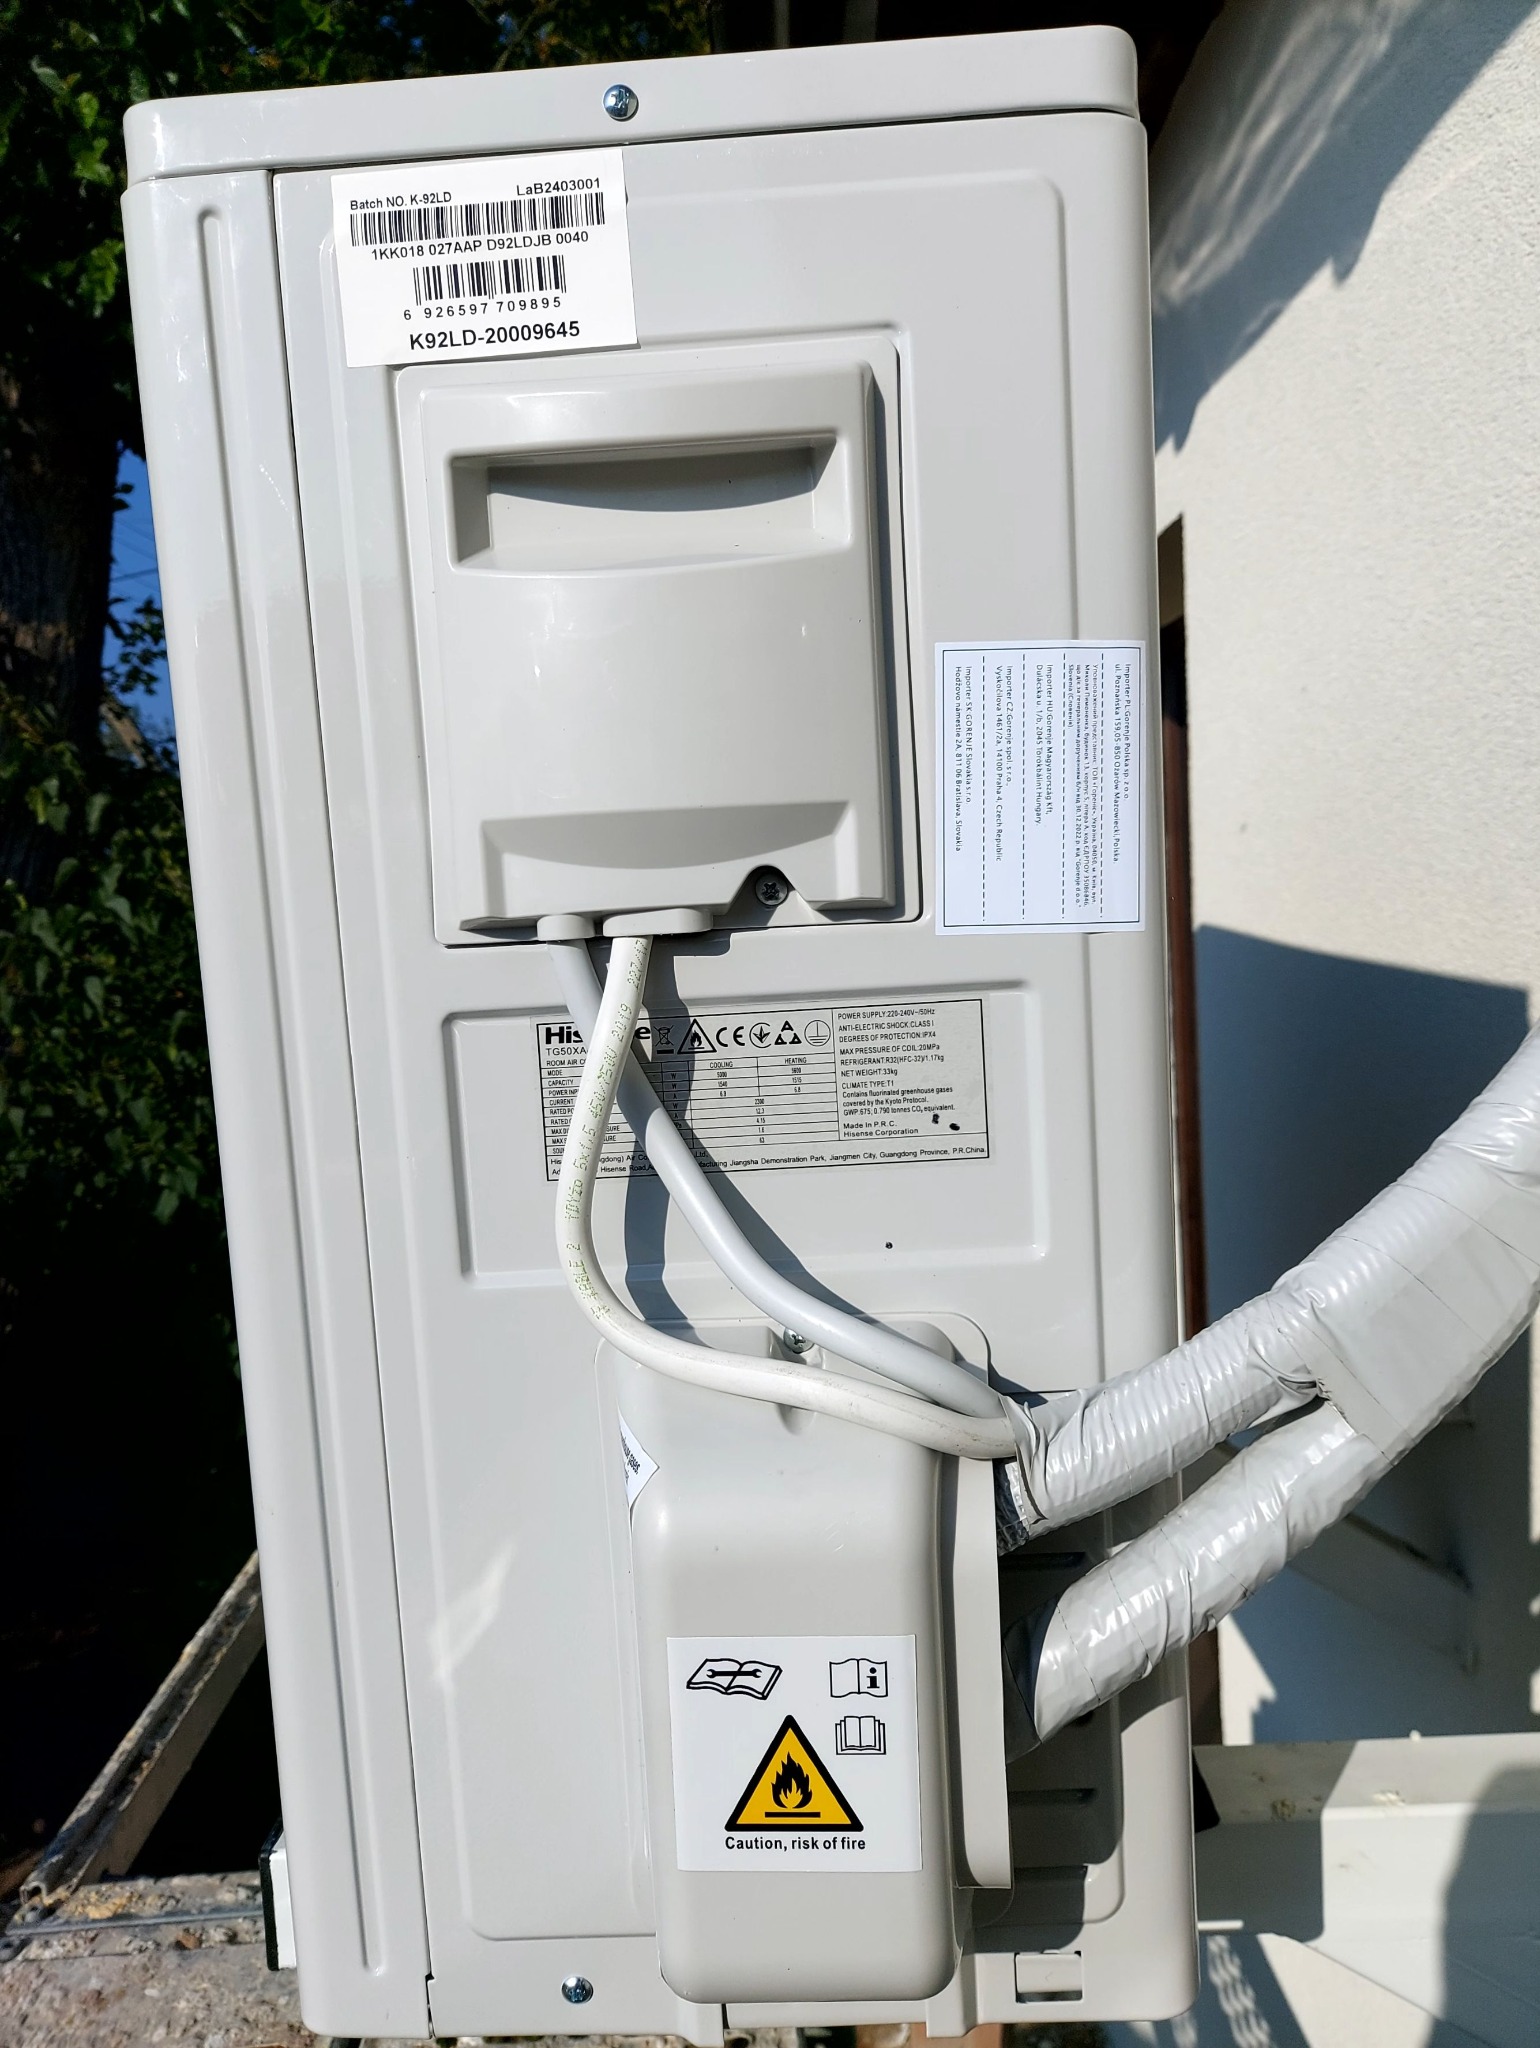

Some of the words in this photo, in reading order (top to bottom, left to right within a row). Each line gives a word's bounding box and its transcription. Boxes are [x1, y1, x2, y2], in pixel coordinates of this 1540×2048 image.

[517, 178, 600, 196] LaB2403001
[350, 197, 383, 211] Batch
[386, 195, 407, 208] NO.
[410, 192, 451, 205] K-92LD
[372, 245, 424, 261] 1KK018
[429, 240, 482, 256] 027AAP
[488, 235, 551, 251] D92LDJB
[556, 230, 589, 245] 0040
[404, 309, 412, 320] 6
[424, 303, 488, 319] 926597
[497, 297, 561, 313] 709895
[409, 321, 580, 351] K92LD-20009645
[1005, 702, 1013, 744] CZ:Gorenje
[1045, 701, 1053, 744] HU:Gorenje
[1123, 700, 1131, 741] PL:Gorenje
[1005, 747, 1013, 764] spol.
[956, 769, 962, 778] 06
[1045, 747, 1053, 800] Magyarország
[546, 1026, 651, 1045] Hise
[546, 1047, 588, 1056] TG50XA
[855, 1046, 890, 1054] PRESSURE
[901, 1088, 934, 1096] greenhouse
[885, 1098, 901, 1106] Kyoto
[875, 1128, 918, 1136] Corporation
[761, 1157, 808, 1165] Demonstration
[863, 1152, 877, 1160] City,
[880, 1150, 917, 1158] Guangdong
[920, 1148, 950, 1156] Province,
[725, 1836, 788, 1851] Caution,
[791, 1836, 819, 1849] risk
[823, 1836, 837, 1849] of
[841, 1836, 866, 1849] fire
